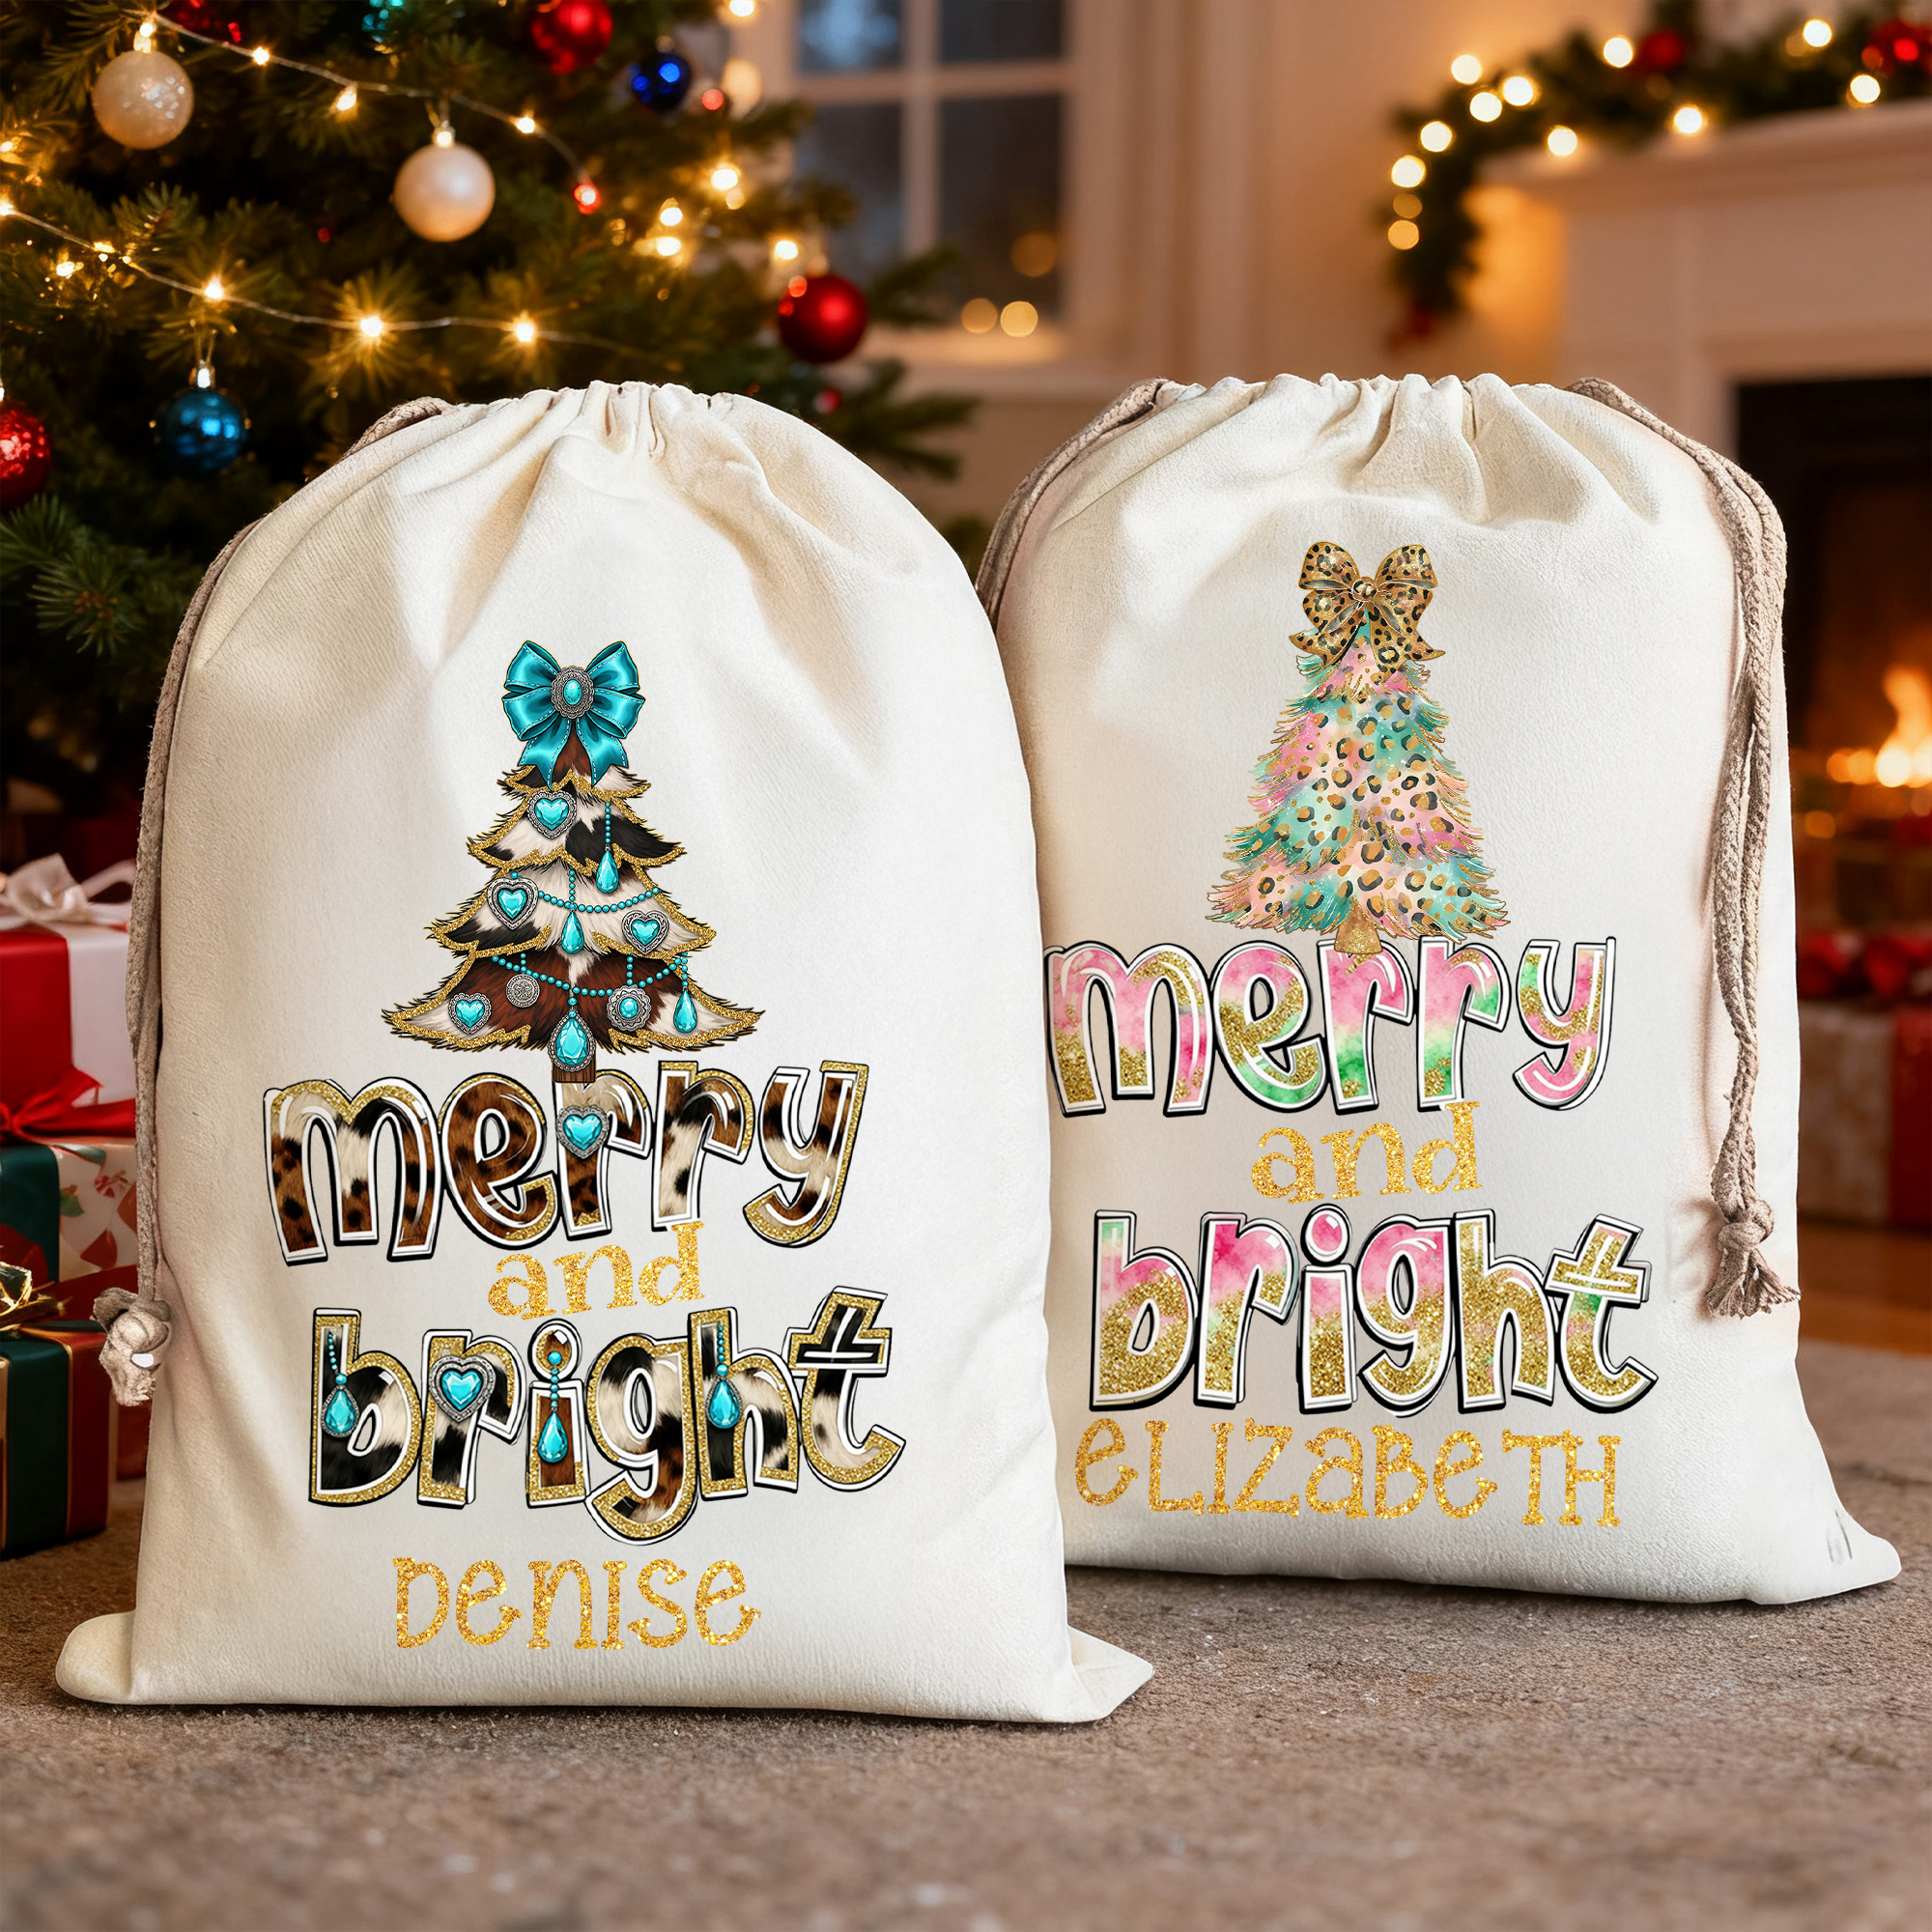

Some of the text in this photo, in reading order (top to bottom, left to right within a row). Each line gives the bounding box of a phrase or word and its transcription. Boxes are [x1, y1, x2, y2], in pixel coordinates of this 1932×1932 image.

[1043, 935, 1616, 1117] merry
[263, 1060, 869, 1265] merry
[1251, 1101, 1483, 1204] and
[487, 1221, 705, 1321] and
[1090, 1204, 1658, 1417] bright
[308, 1286, 906, 1546] bright
